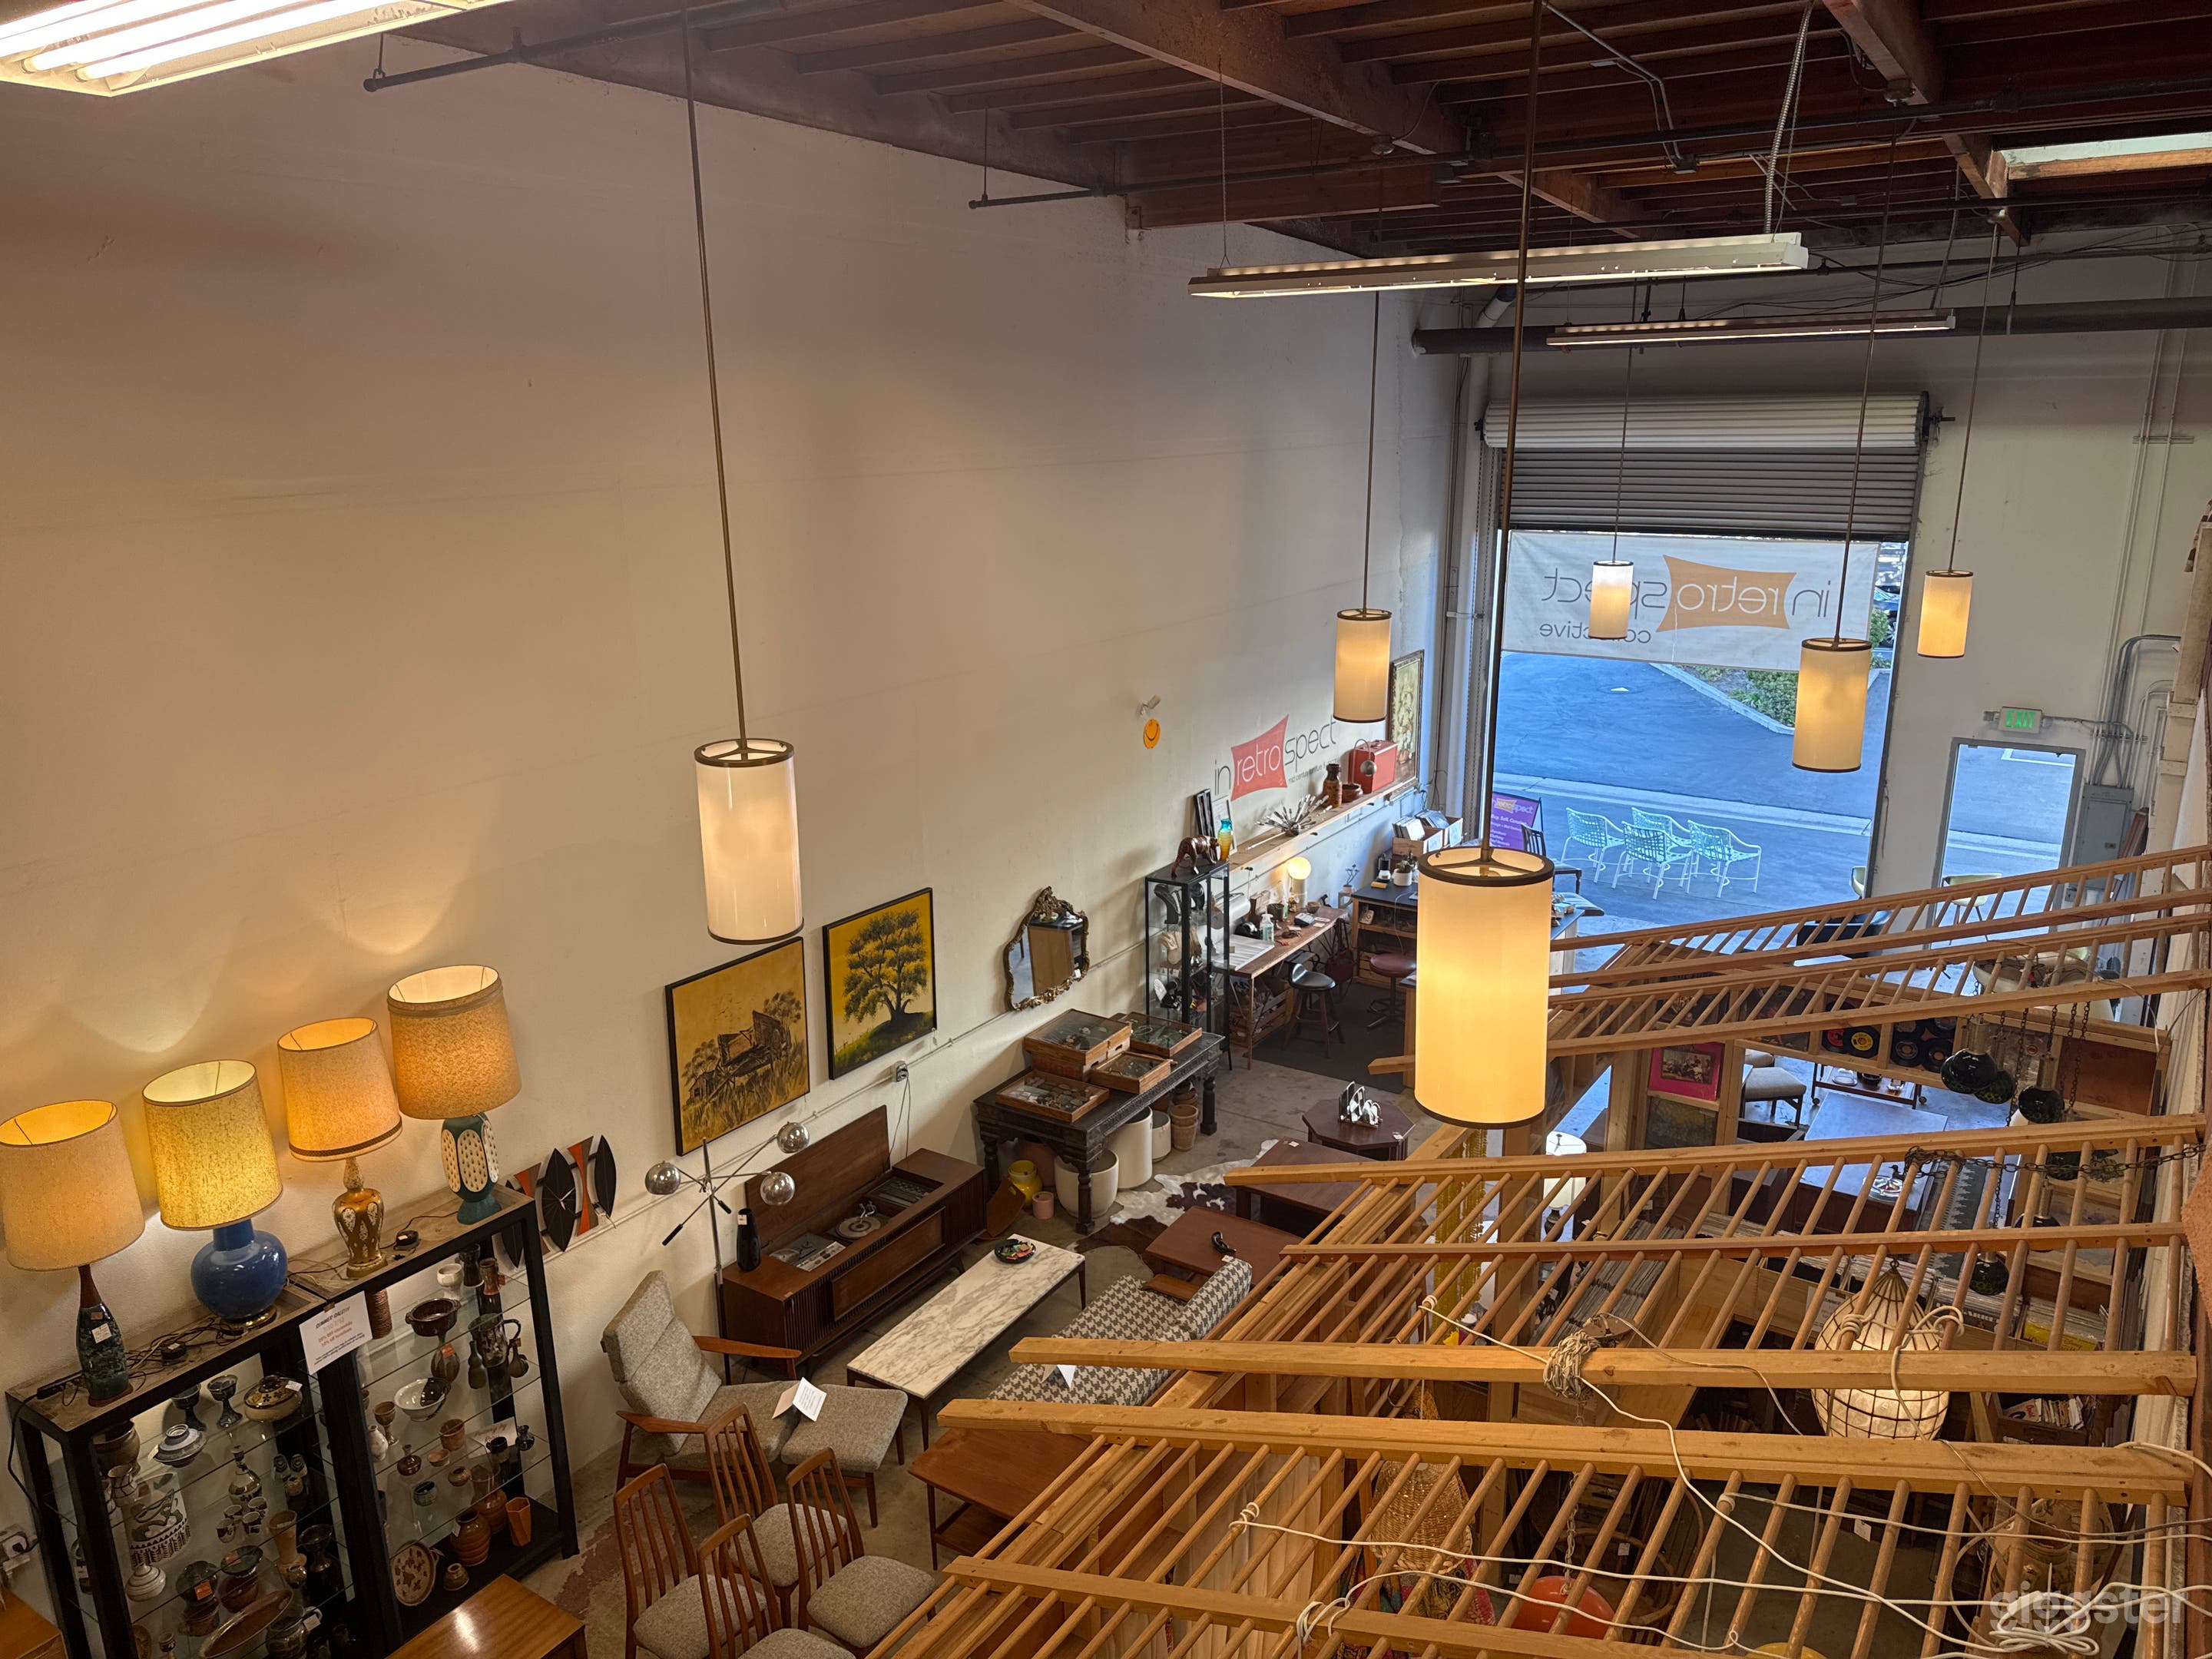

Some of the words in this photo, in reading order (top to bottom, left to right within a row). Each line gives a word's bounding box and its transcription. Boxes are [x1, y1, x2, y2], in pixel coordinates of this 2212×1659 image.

[2005, 710, 2036, 729] EXIT
[1236, 743, 1282, 786] retro
[1284, 714, 1337, 772] spect
